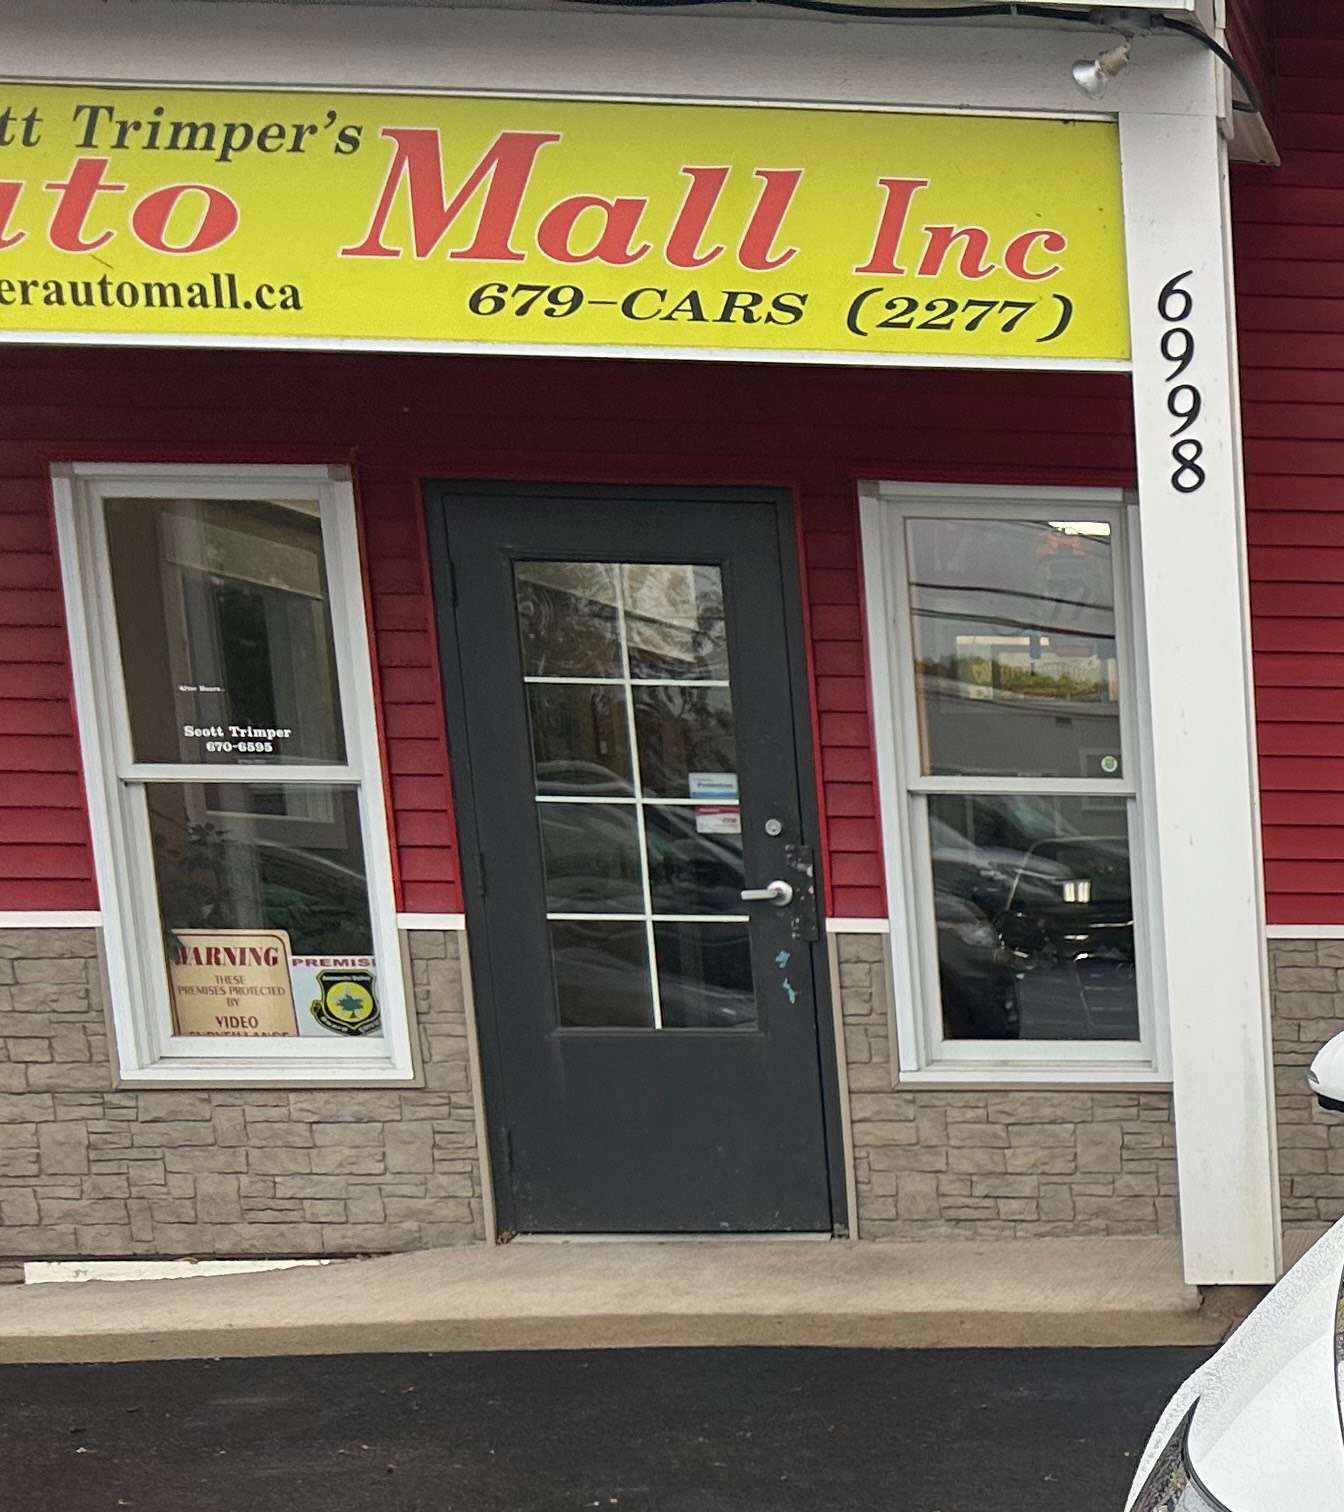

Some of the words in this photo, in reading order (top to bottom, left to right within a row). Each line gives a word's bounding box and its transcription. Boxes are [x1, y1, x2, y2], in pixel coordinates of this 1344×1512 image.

[72, 104, 364, 162] Trimper's
[337, 127, 804, 273] Mall
[852, 176, 1069, 283] Inc
[467, 282, 809, 327] 679-CARS
[846, 287, 1074, 343] (2277)
[1157, 270, 1206, 494] 6998
[184, 725, 225, 738] Scott
[229, 726, 291, 740] Trimper
[174, 946, 279, 967] WARNING
[292, 958, 376, 967] PREMIS
[215, 975, 246, 984] THESE
[178, 985, 226, 995] PREMISES
[229, 986, 286, 996] PROTECTED
[227, 997, 240, 1007] BY
[216, 1015, 259, 1029] VIDEO
